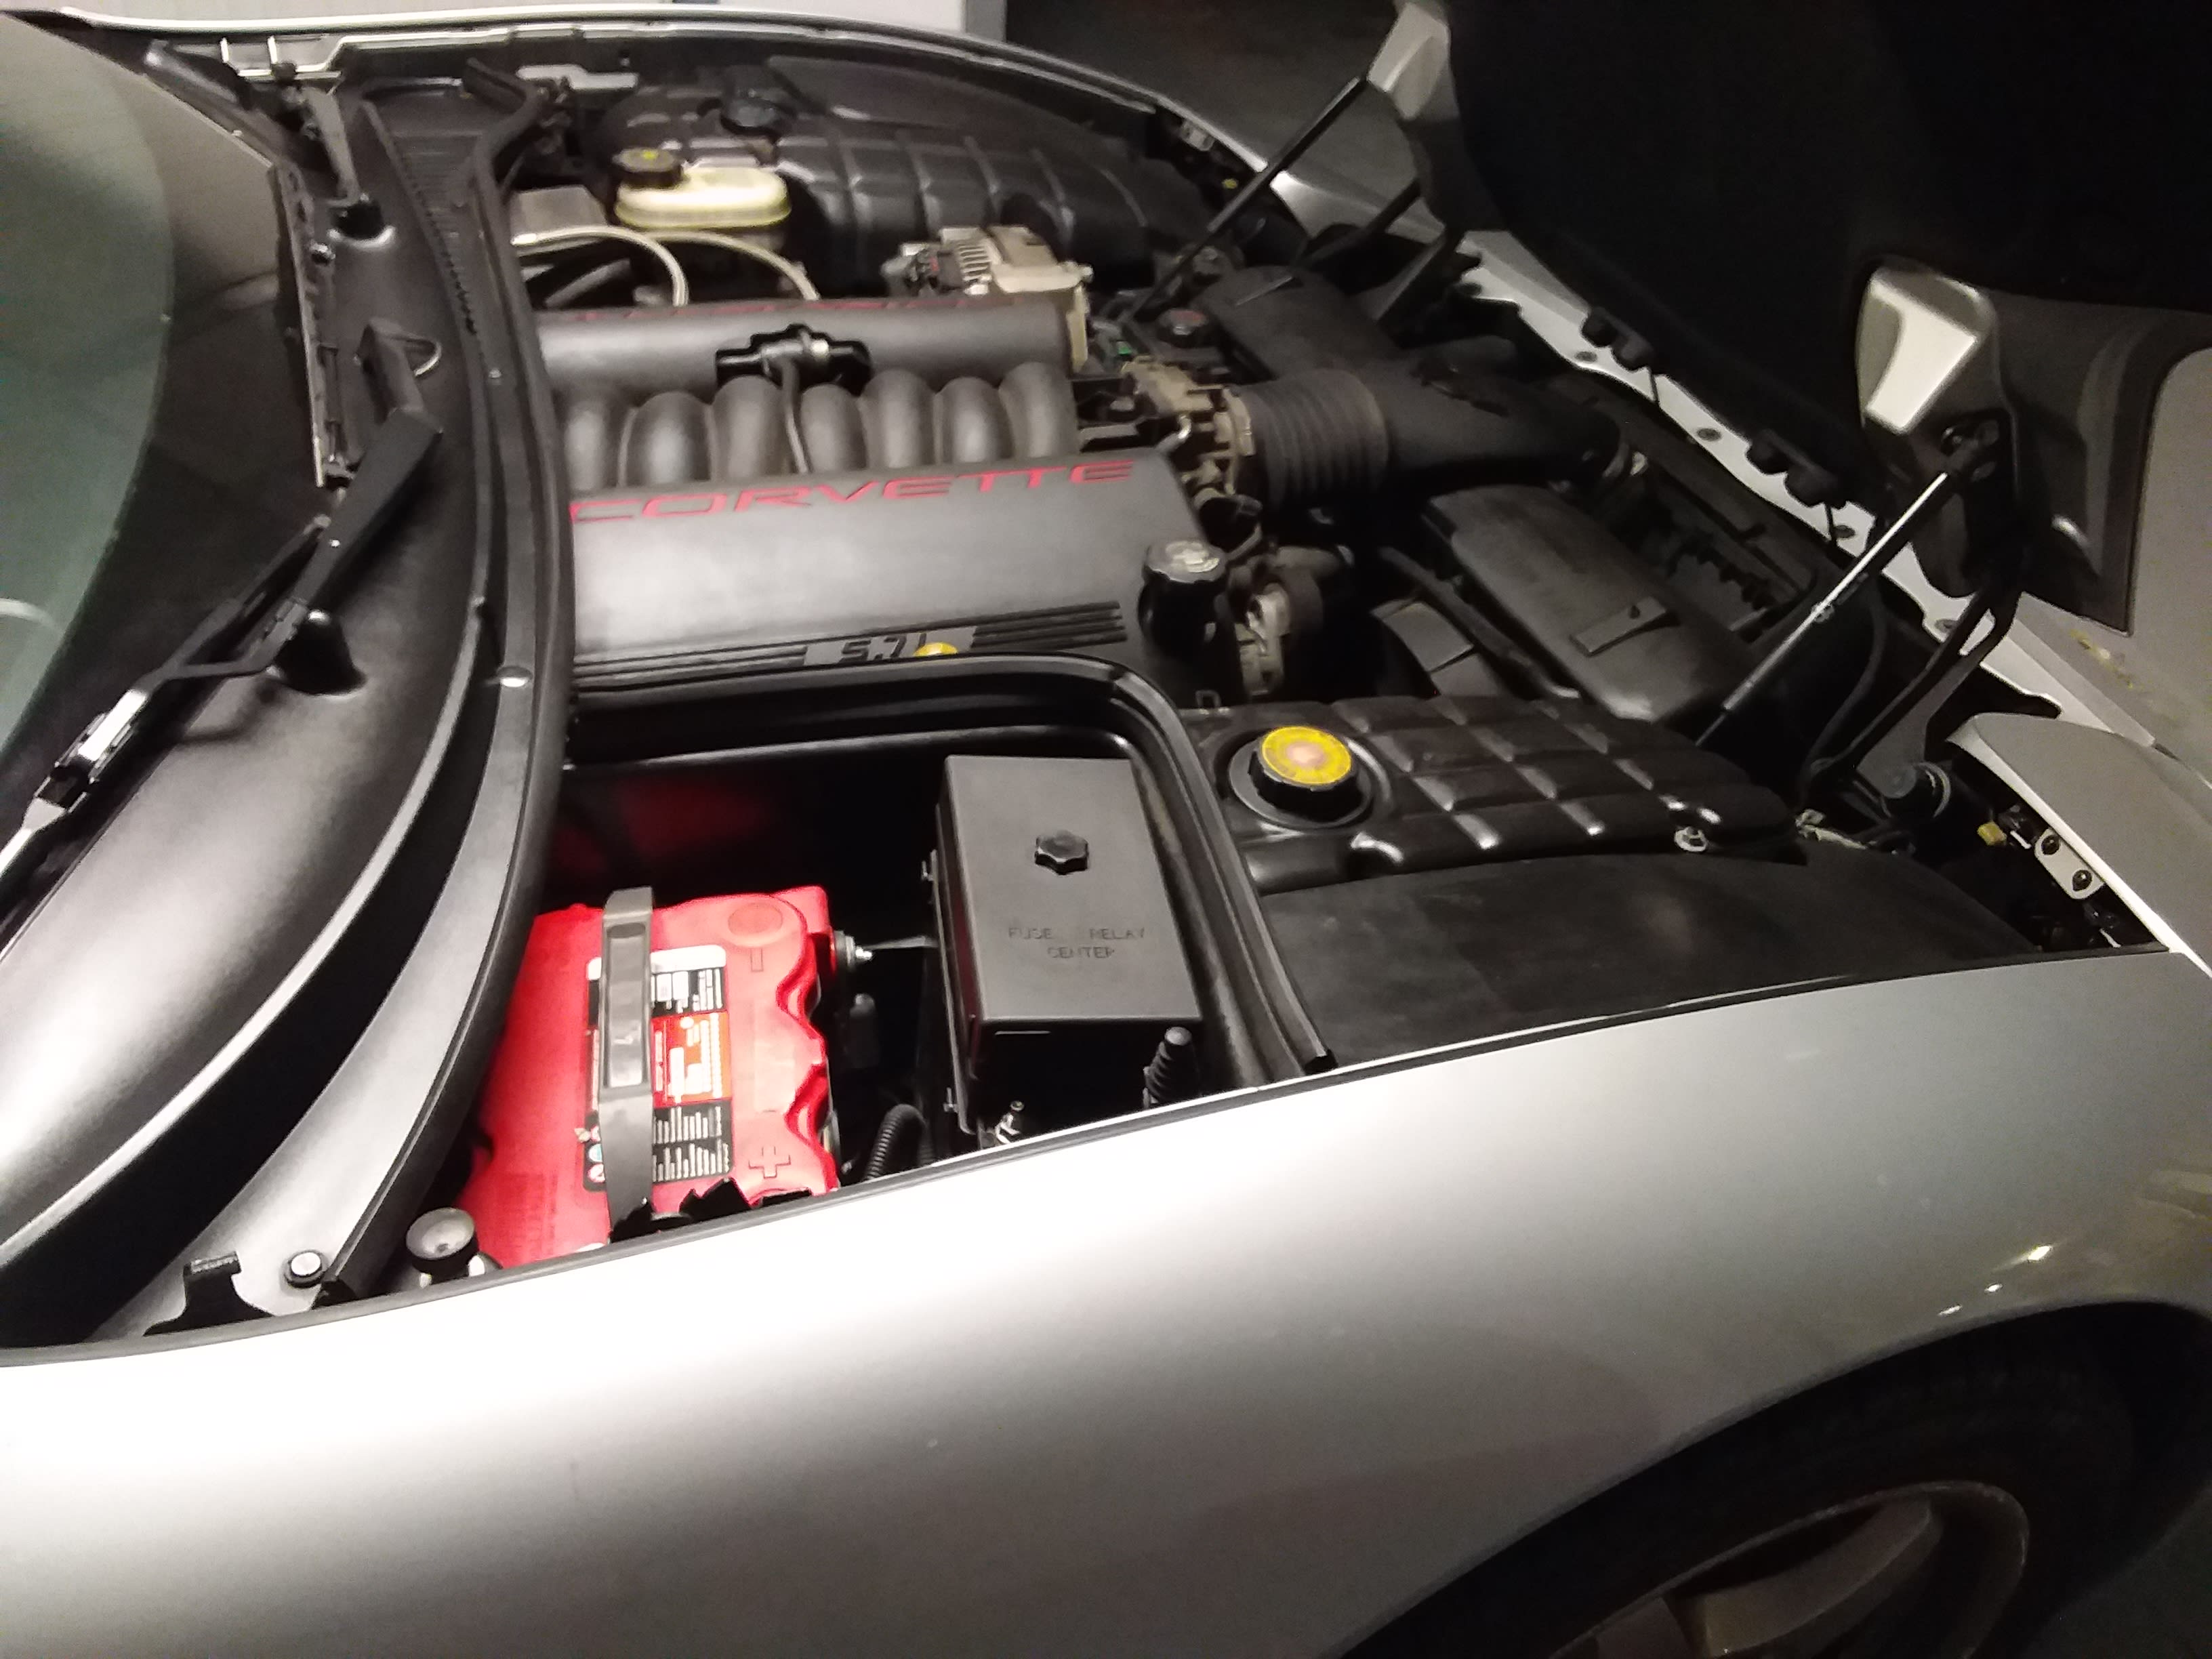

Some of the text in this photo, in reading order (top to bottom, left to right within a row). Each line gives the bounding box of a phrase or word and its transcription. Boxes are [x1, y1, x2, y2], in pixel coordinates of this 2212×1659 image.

[569, 459, 1136, 524] CORVETTE
[1008, 926, 1145, 940] FUSE RELAY
[1048, 946, 1115, 959] CENTER
